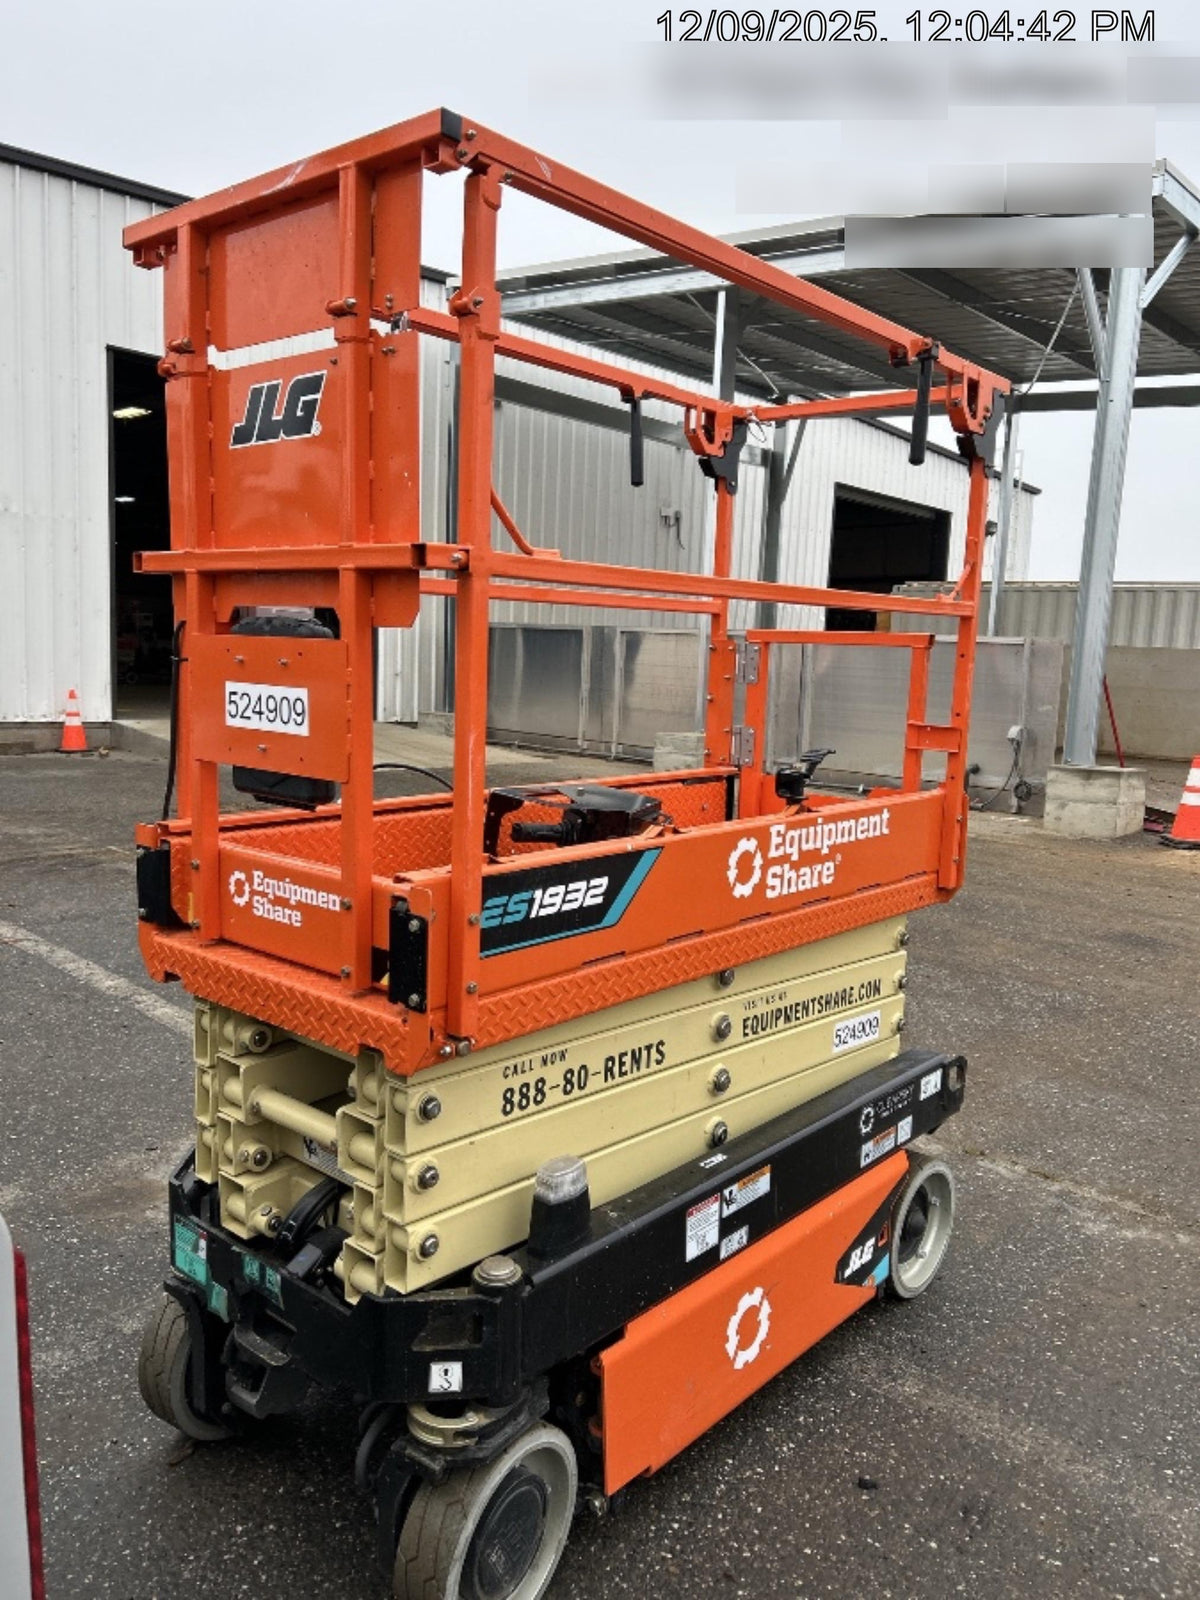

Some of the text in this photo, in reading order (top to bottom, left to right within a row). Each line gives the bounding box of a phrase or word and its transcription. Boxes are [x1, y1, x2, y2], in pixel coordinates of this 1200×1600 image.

[229, 369, 327, 450] JLG
[227, 690, 306, 727] 524909
[767, 808, 890, 861] Equipment
[252, 895, 303, 928] Share
[481, 876, 609, 929] ES1932
[742, 978, 882, 1038] EQUIPMENTSHARE.COM
[501, 1039, 667, 1117] 888-80-RENTS
[502, 1048, 569, 1080] CALL NOW
